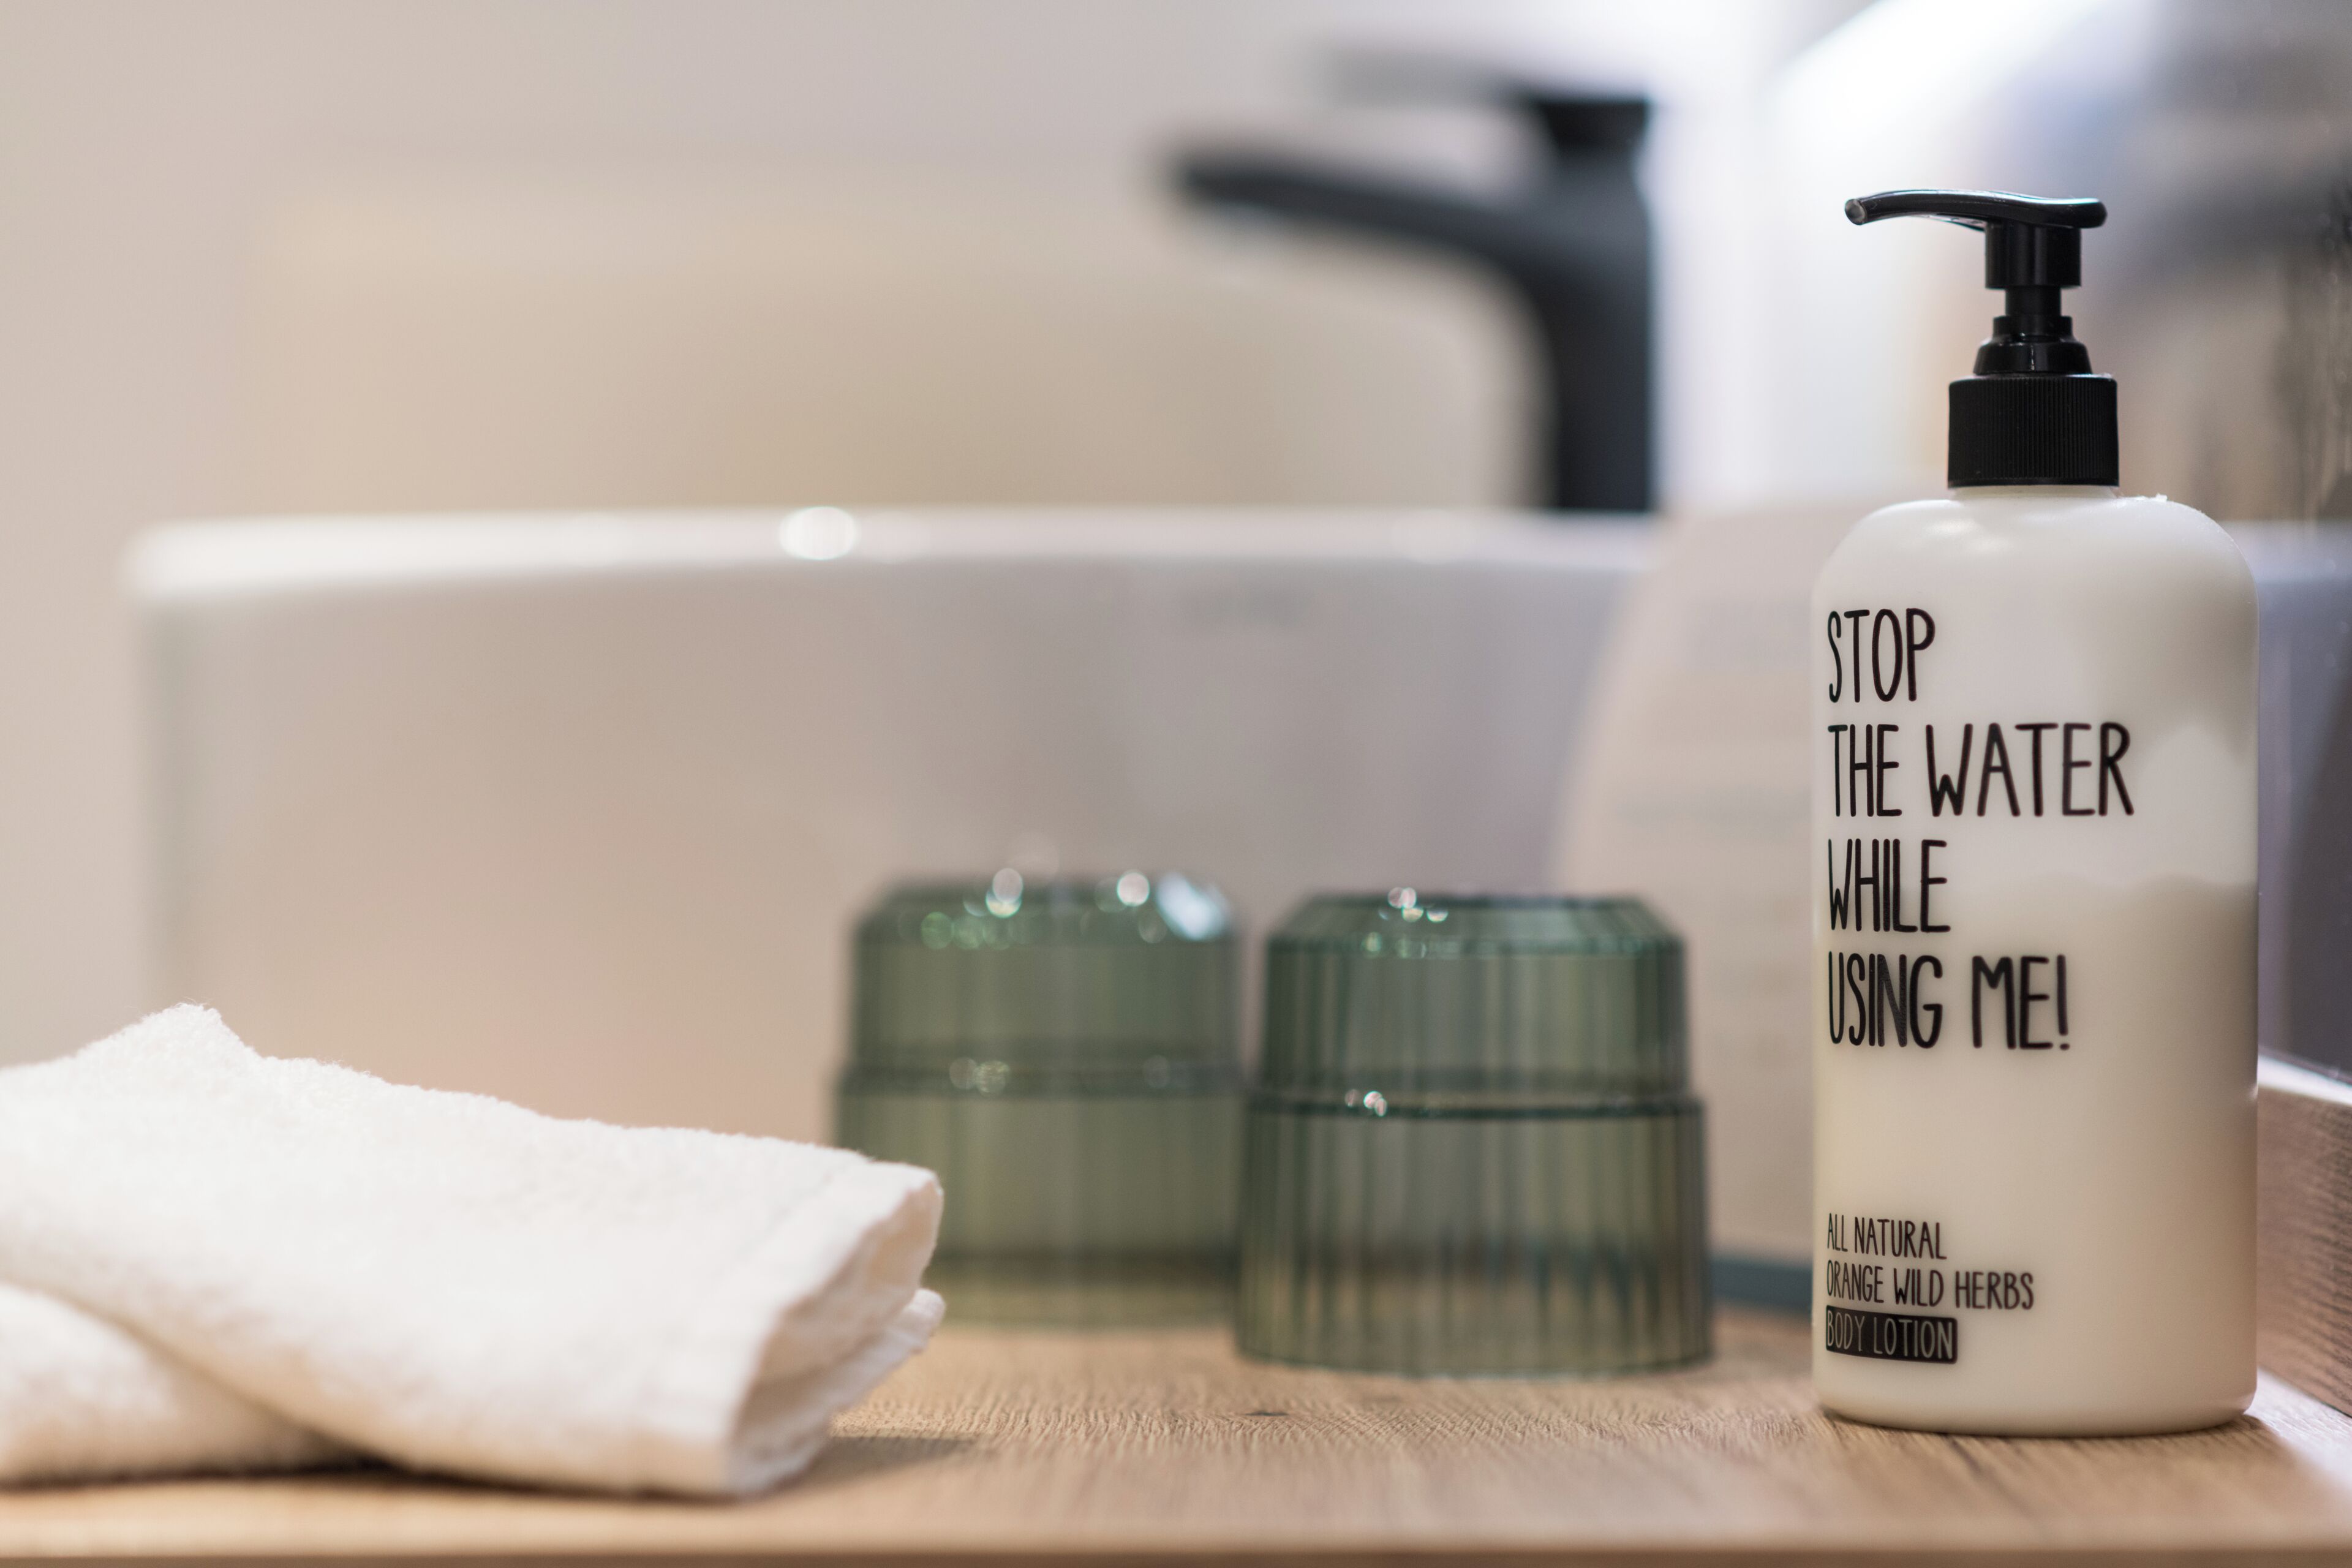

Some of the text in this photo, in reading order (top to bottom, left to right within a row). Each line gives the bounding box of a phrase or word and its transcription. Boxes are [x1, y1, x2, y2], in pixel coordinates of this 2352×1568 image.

[1827, 608, 1936, 703] STOP
[1828, 722, 2134, 817] THE WATER
[1828, 839, 1951, 932] WHILE
[1828, 951, 2070, 1050] USING ME!
[1827, 1213, 1947, 1259] ALL NATURAL
[1826, 1260, 2034, 1310] ORANGE WILD HERBS
[1826, 1310, 1953, 1359] BODY LOTION
